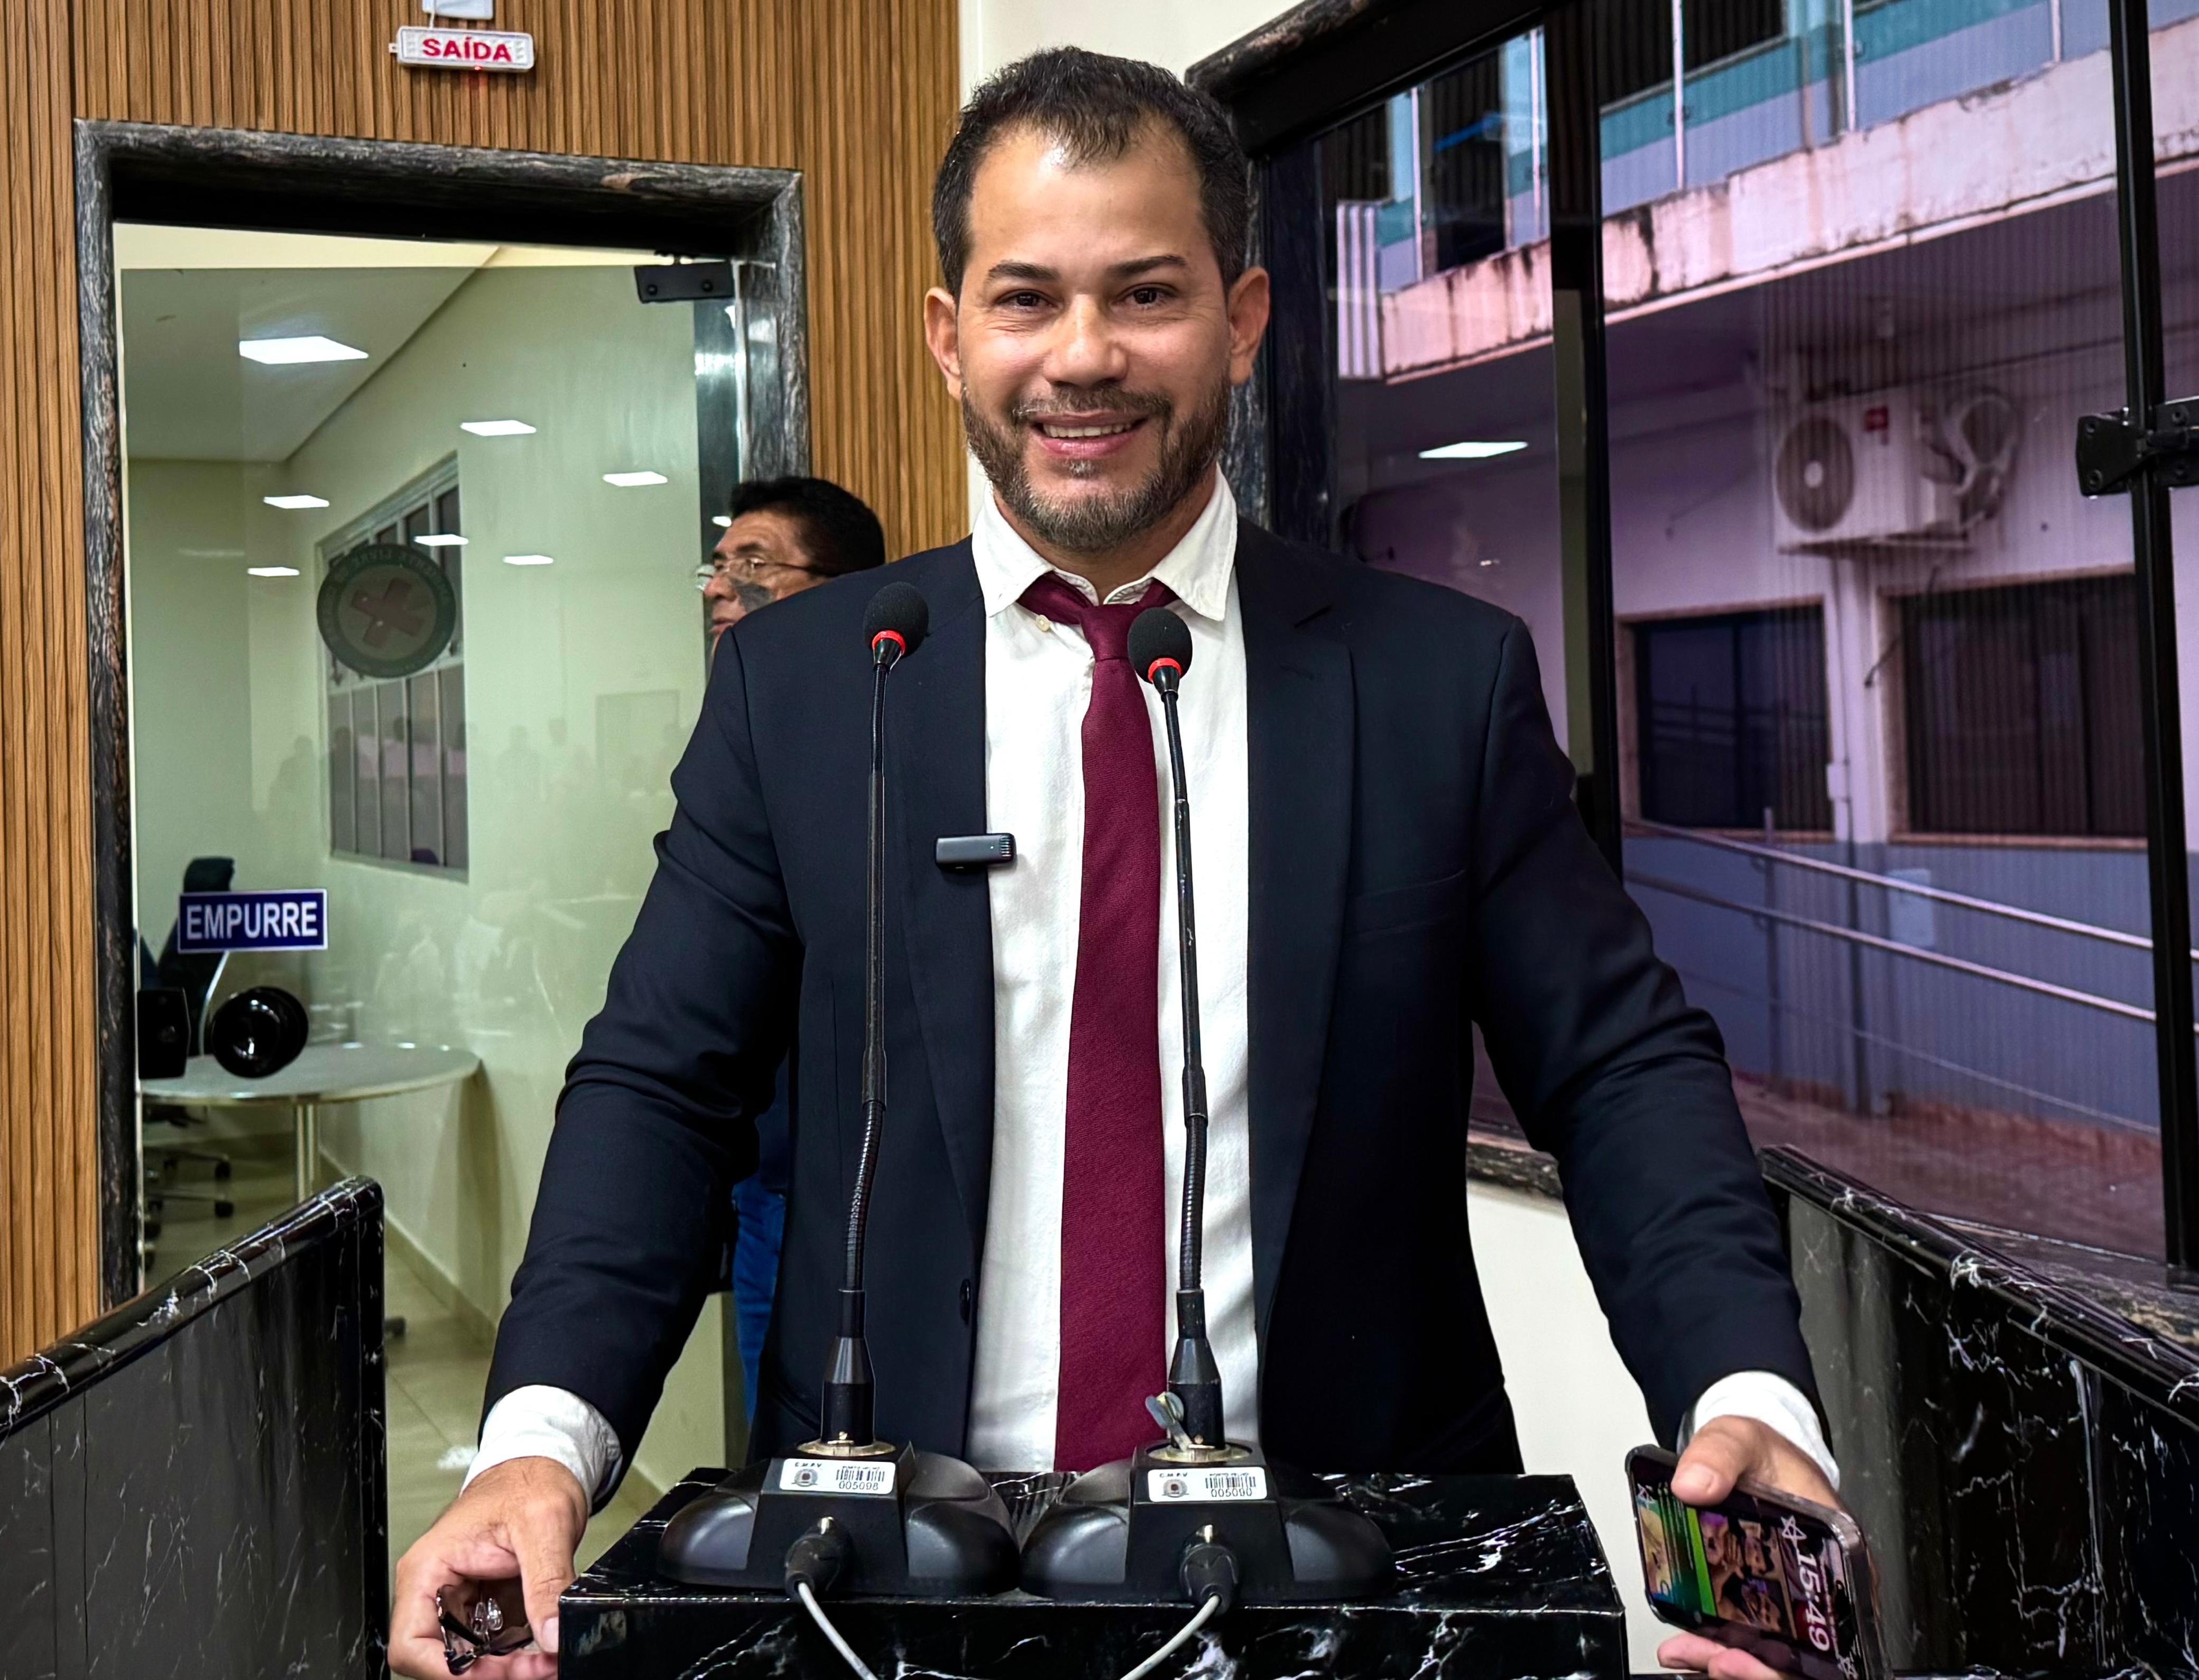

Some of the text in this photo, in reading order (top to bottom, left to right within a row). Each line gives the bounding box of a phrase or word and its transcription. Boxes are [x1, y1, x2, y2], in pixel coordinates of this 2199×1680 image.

[422, 36, 512, 62] SAÍDA
[187, 901, 318, 939] EMPURRE
[1797, 1550, 1830, 1651] 15:49
